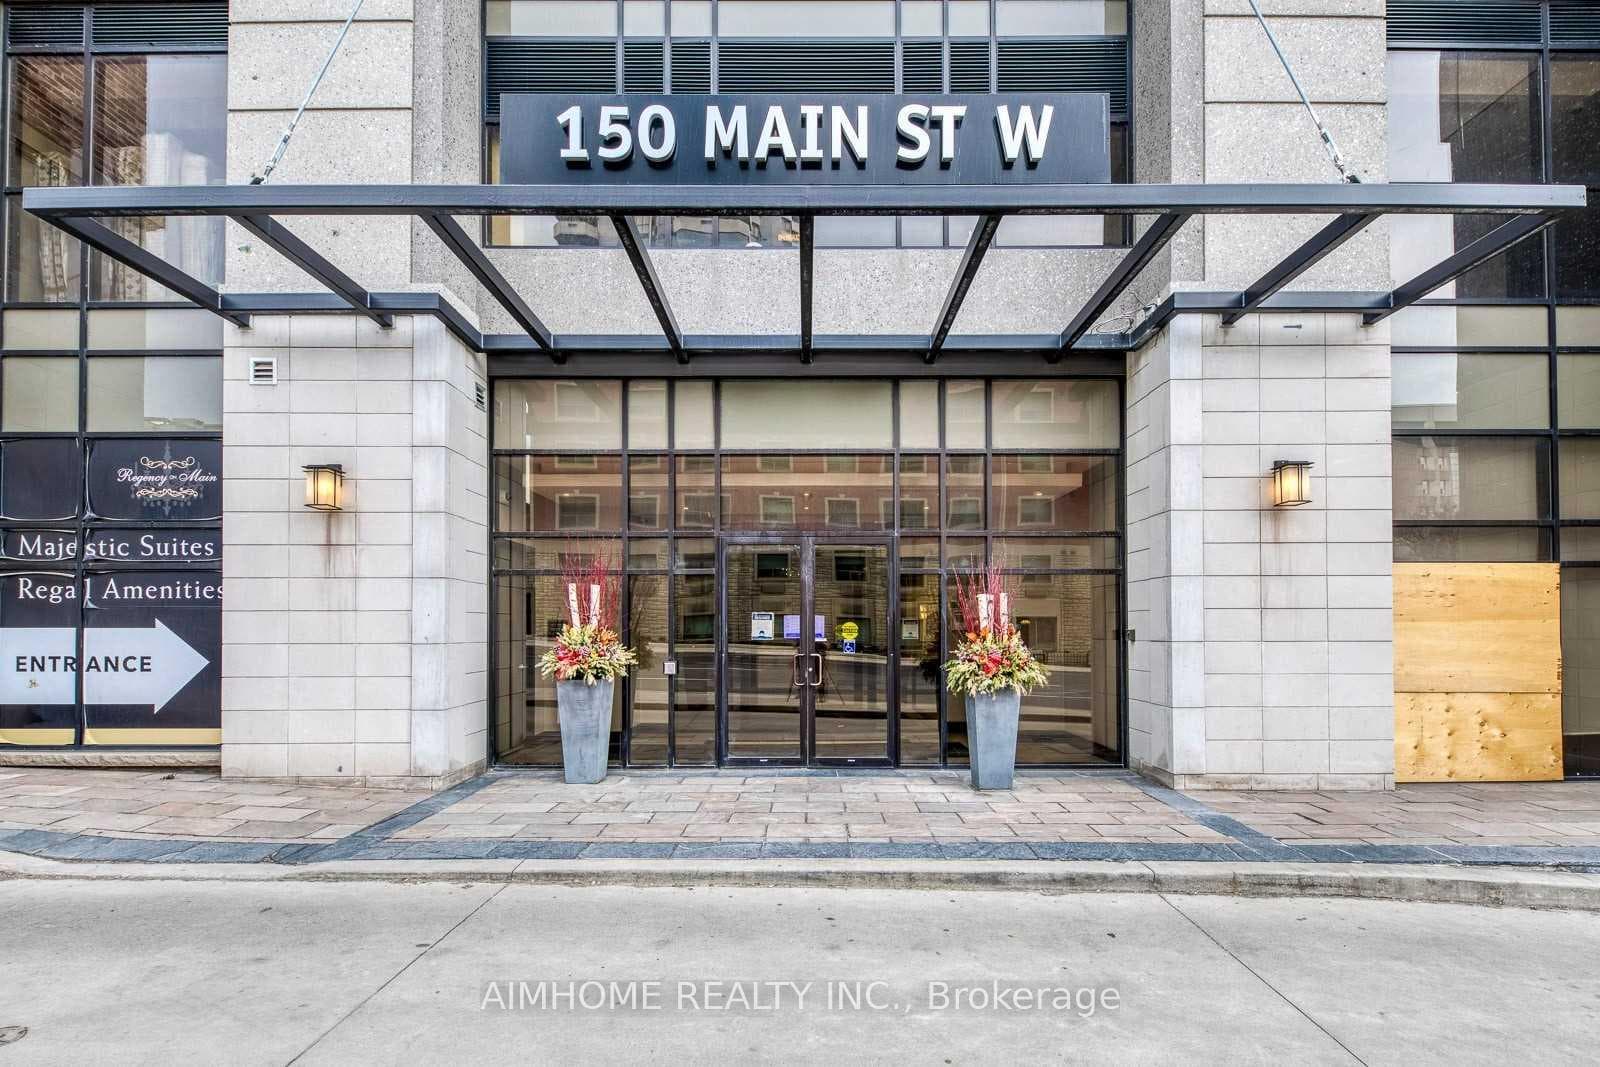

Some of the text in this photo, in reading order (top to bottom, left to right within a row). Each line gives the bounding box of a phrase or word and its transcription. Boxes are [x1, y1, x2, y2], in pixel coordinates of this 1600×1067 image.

[556, 103, 1054, 168] 150 MAIN ST W
[117, 467, 166, 487] Regency
[178, 468, 217, 482] Main
[140, 535, 215, 556] Suites
[18, 577, 91, 604] Regal
[16, 656, 152, 673] ENTRANCE
